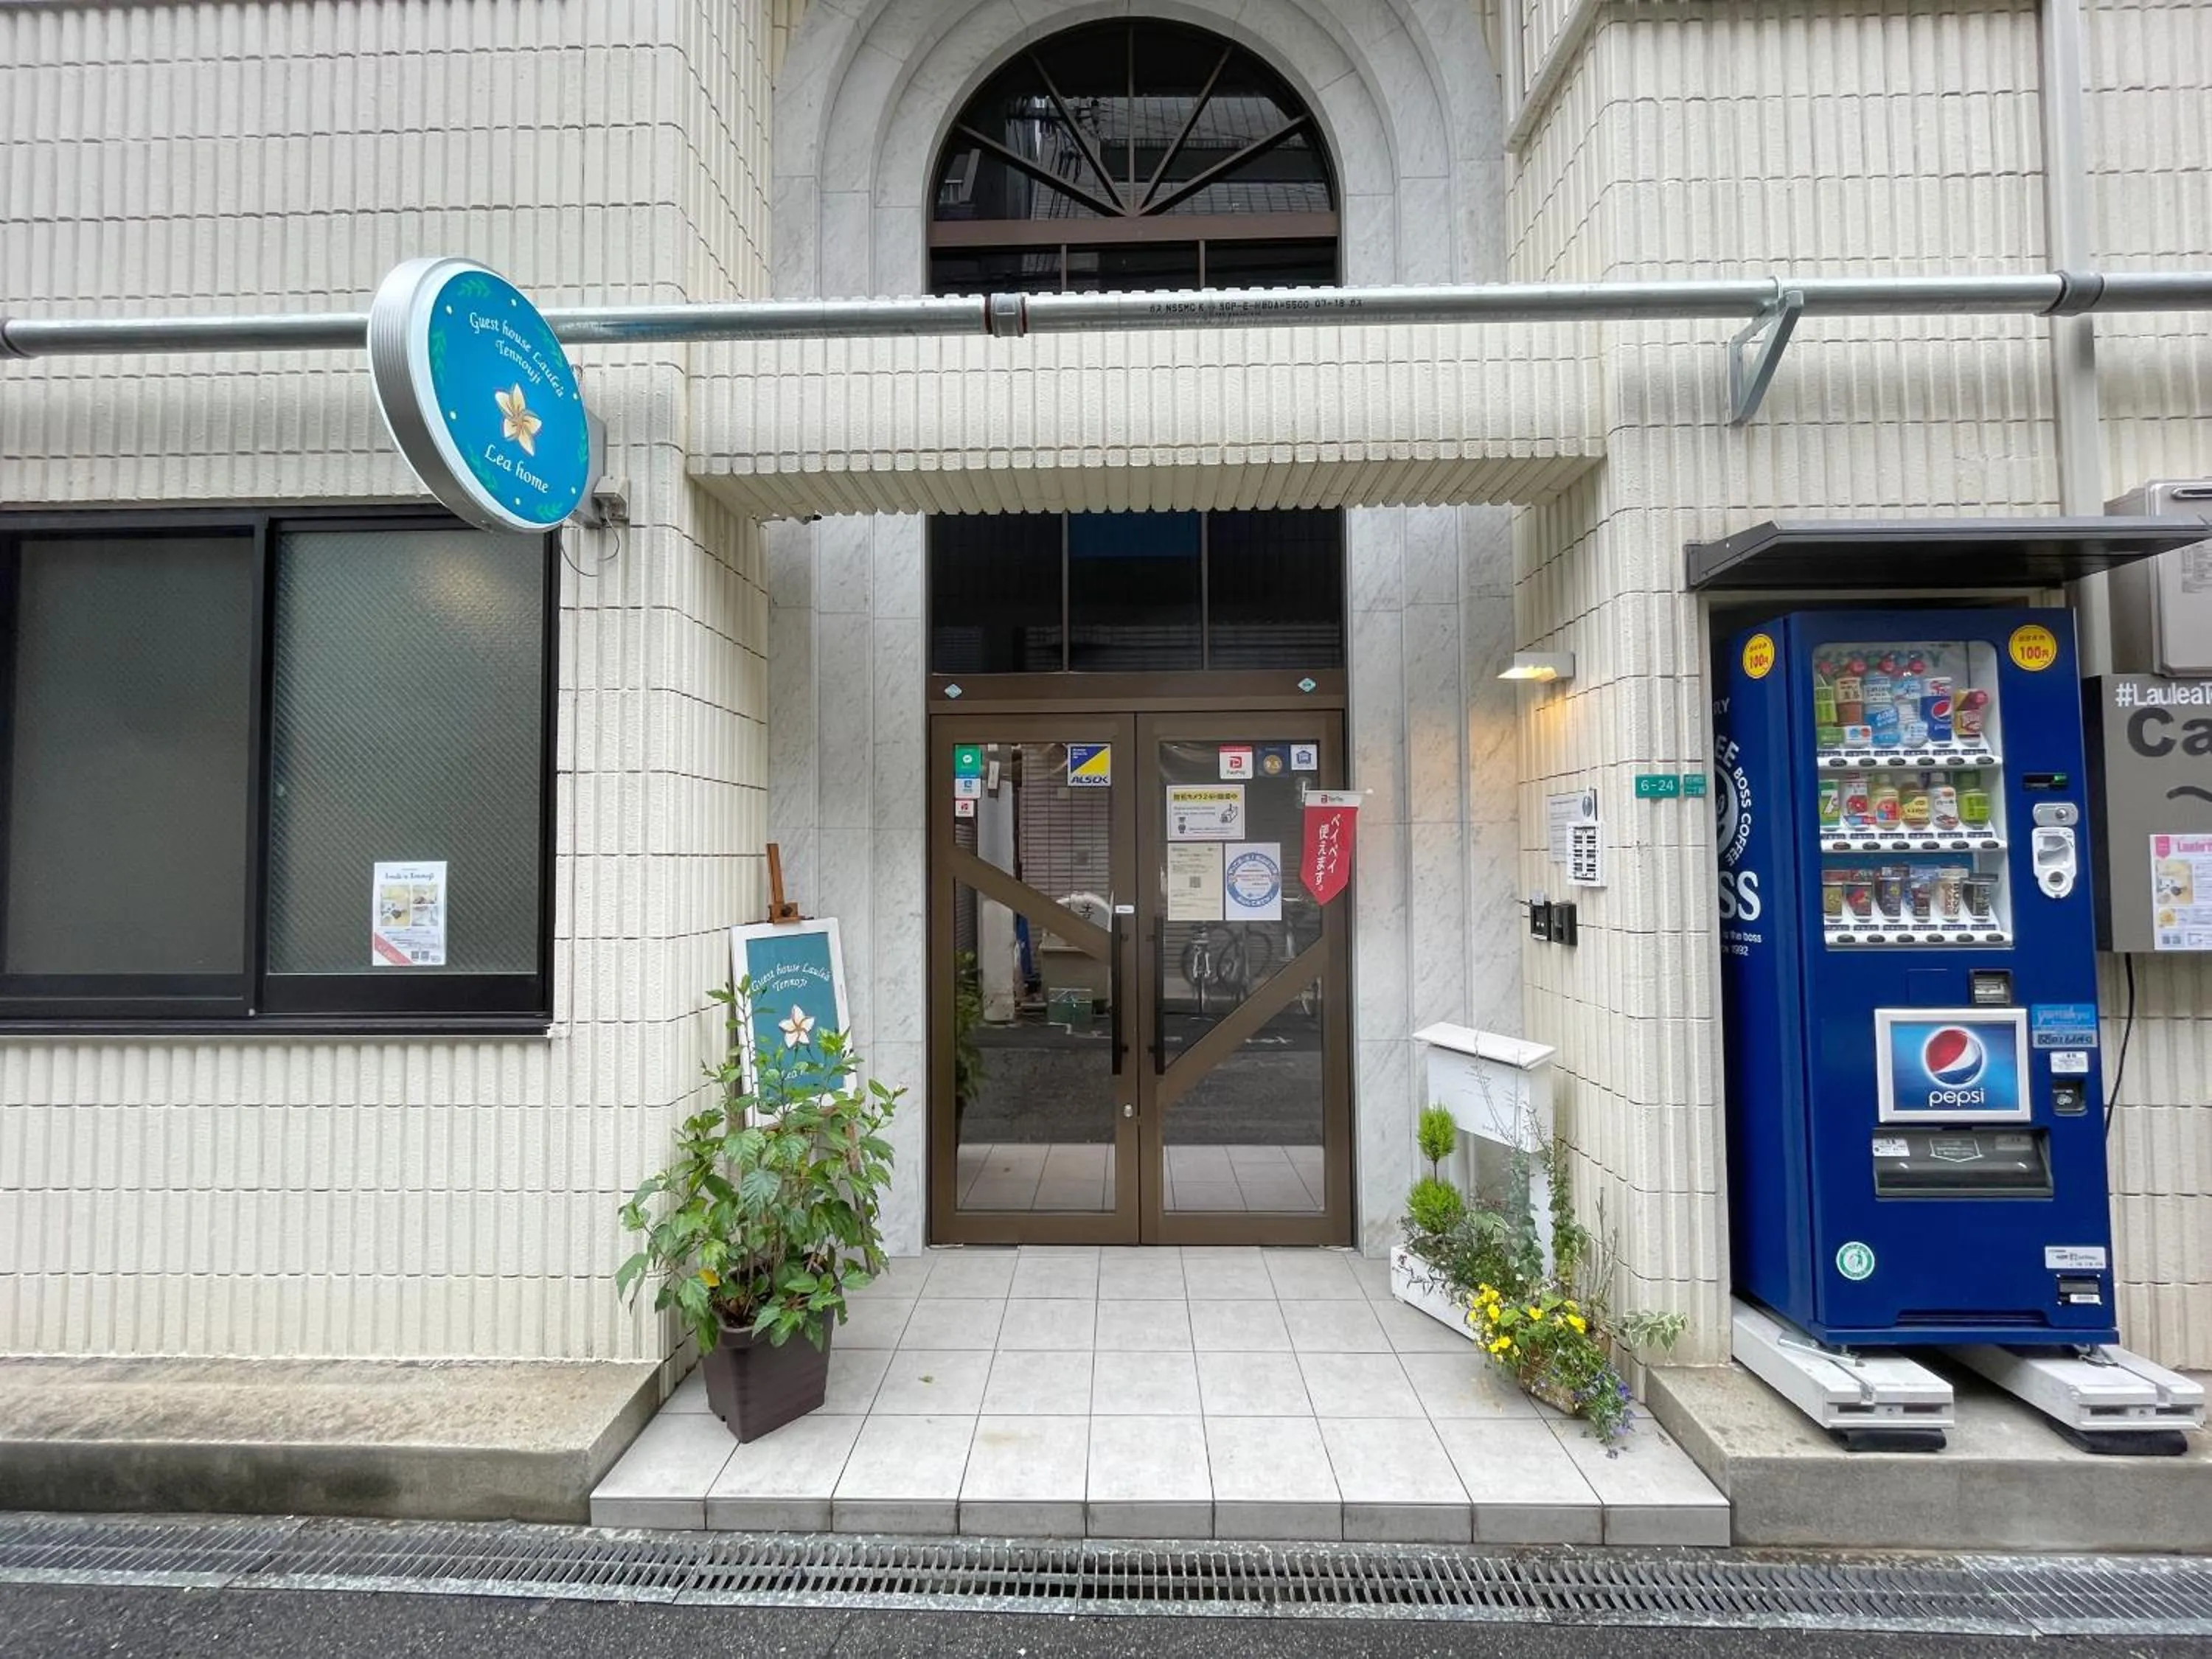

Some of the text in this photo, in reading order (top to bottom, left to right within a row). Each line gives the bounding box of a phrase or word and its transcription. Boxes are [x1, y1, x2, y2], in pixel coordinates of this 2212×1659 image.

[469, 312, 500, 334] Guest
[501, 319, 532, 353] house
[495, 339, 542, 384] Tennouji
[484, 444, 550, 494] Lea home
[2115, 682, 2212, 706] #LauleaT
[2127, 707, 2212, 757] Ca
[1071, 776, 1108, 784] ALSOK
[1641, 779, 1674, 791] 6-24
[1725, 767, 1752, 867] BOSS COFFEE
[1327, 813, 1340, 874] ペイペイ
[1718, 871, 1761, 921] SS
[1929, 1088, 1984, 1107] pepsi
